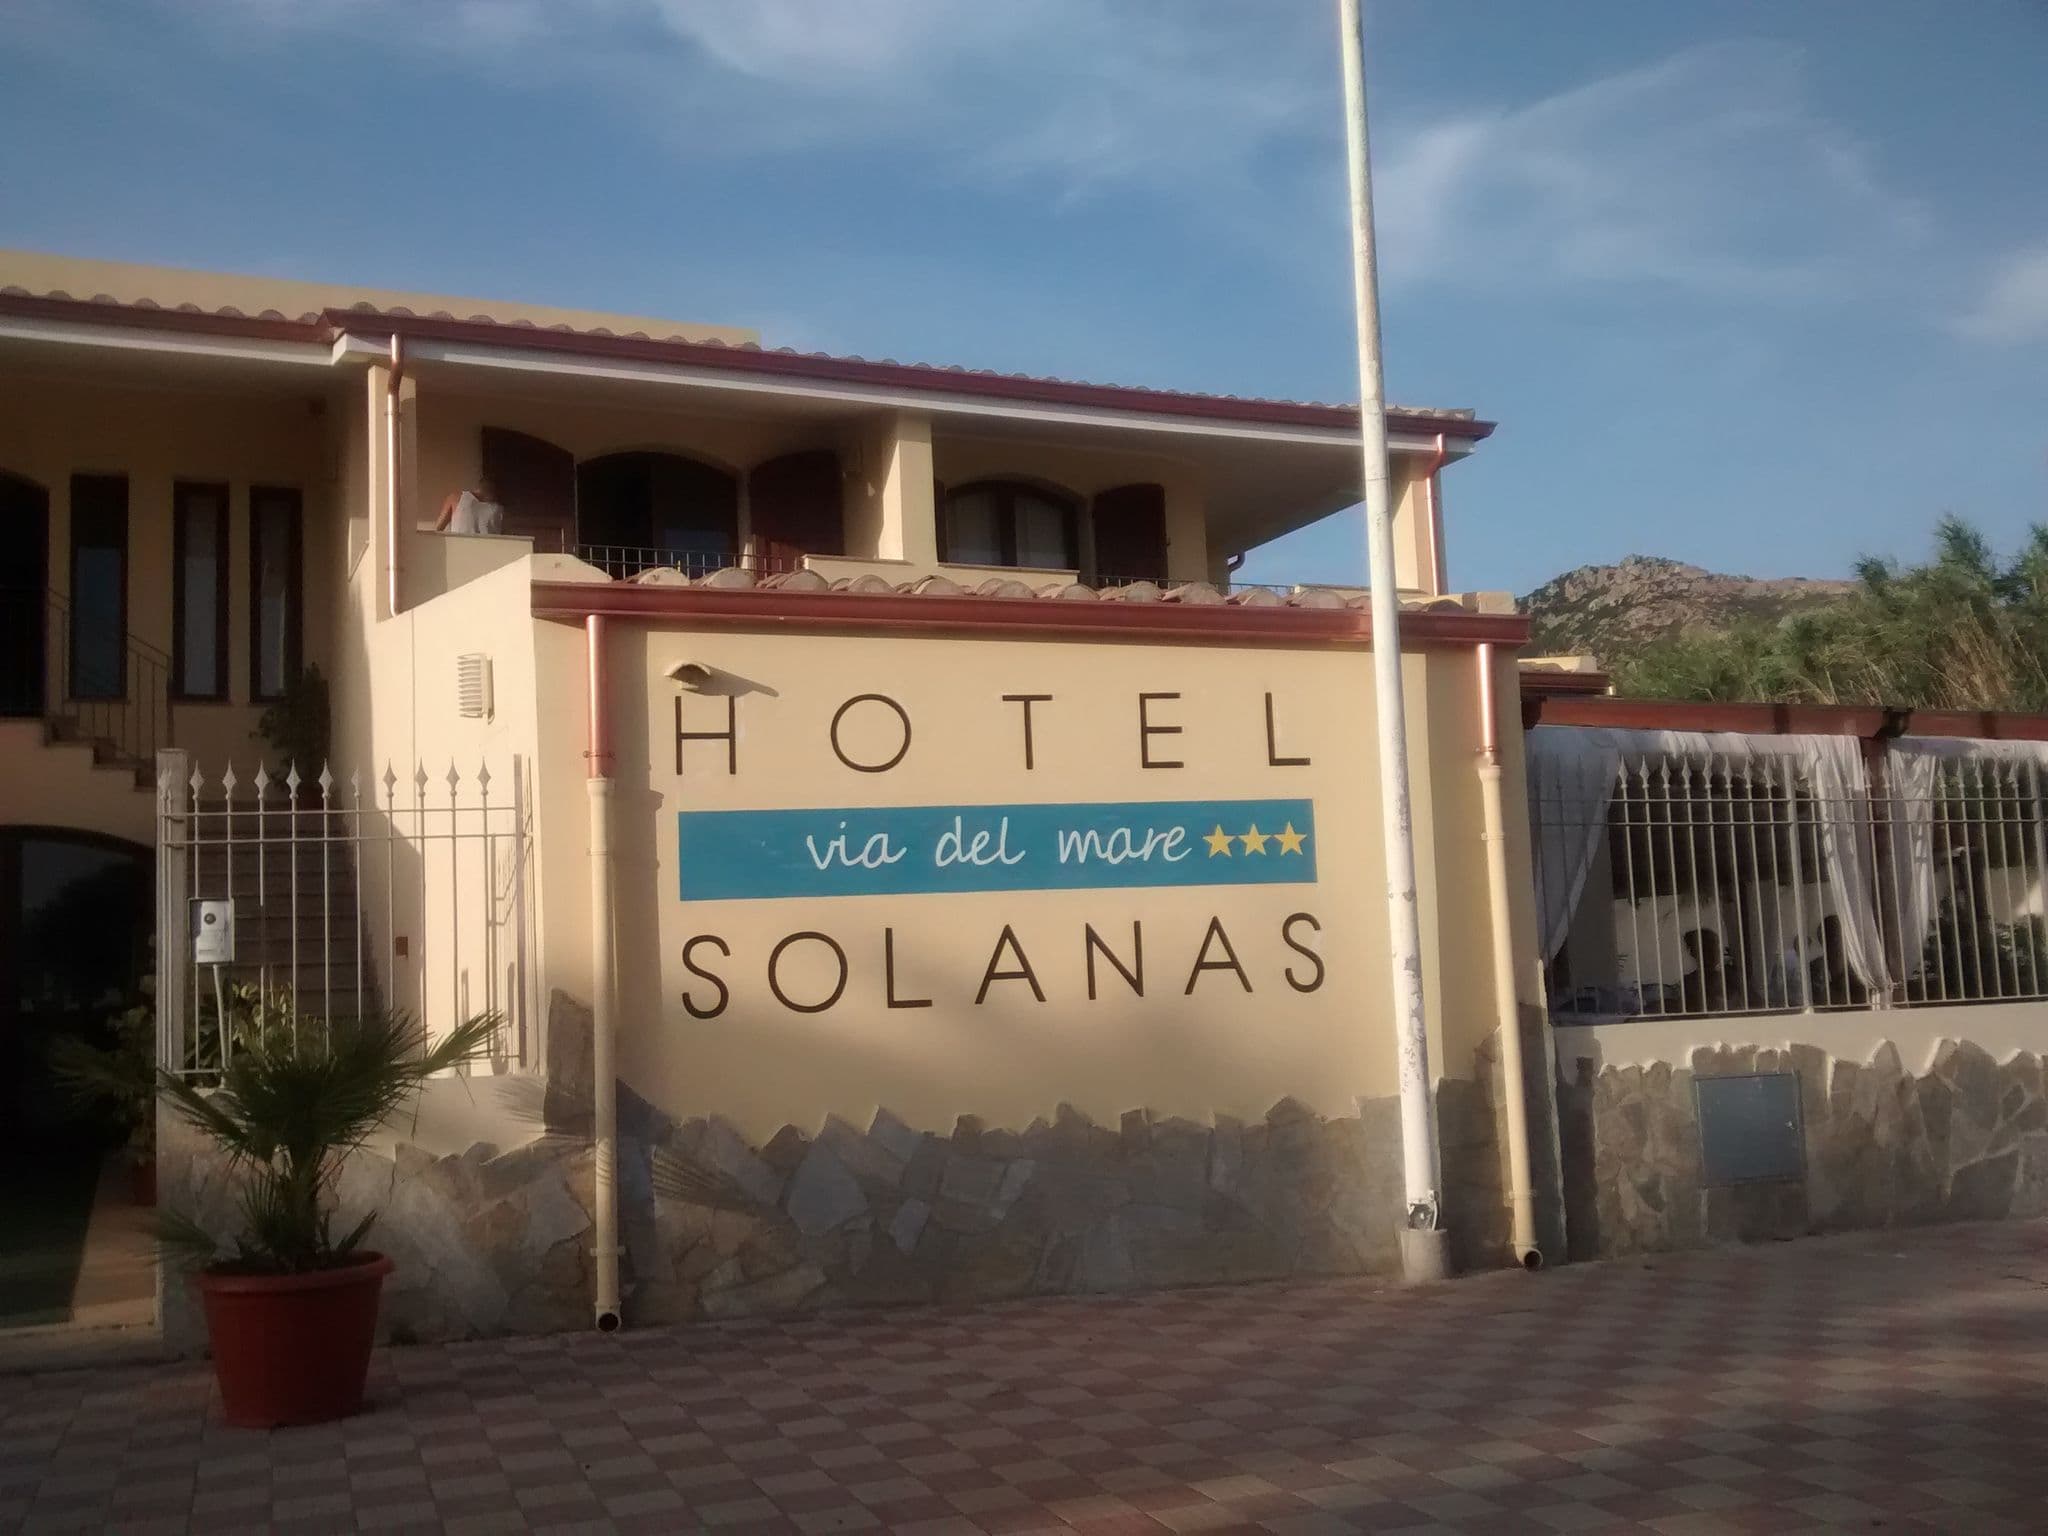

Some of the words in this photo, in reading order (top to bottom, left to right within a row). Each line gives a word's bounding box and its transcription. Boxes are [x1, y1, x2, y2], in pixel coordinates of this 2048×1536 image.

[675, 692, 1311, 776] HOTEL
[805, 821, 907, 870] via
[935, 816, 1026, 866] del
[1058, 824, 1192, 864] mare
[681, 912, 1326, 1021] SOLANAS
